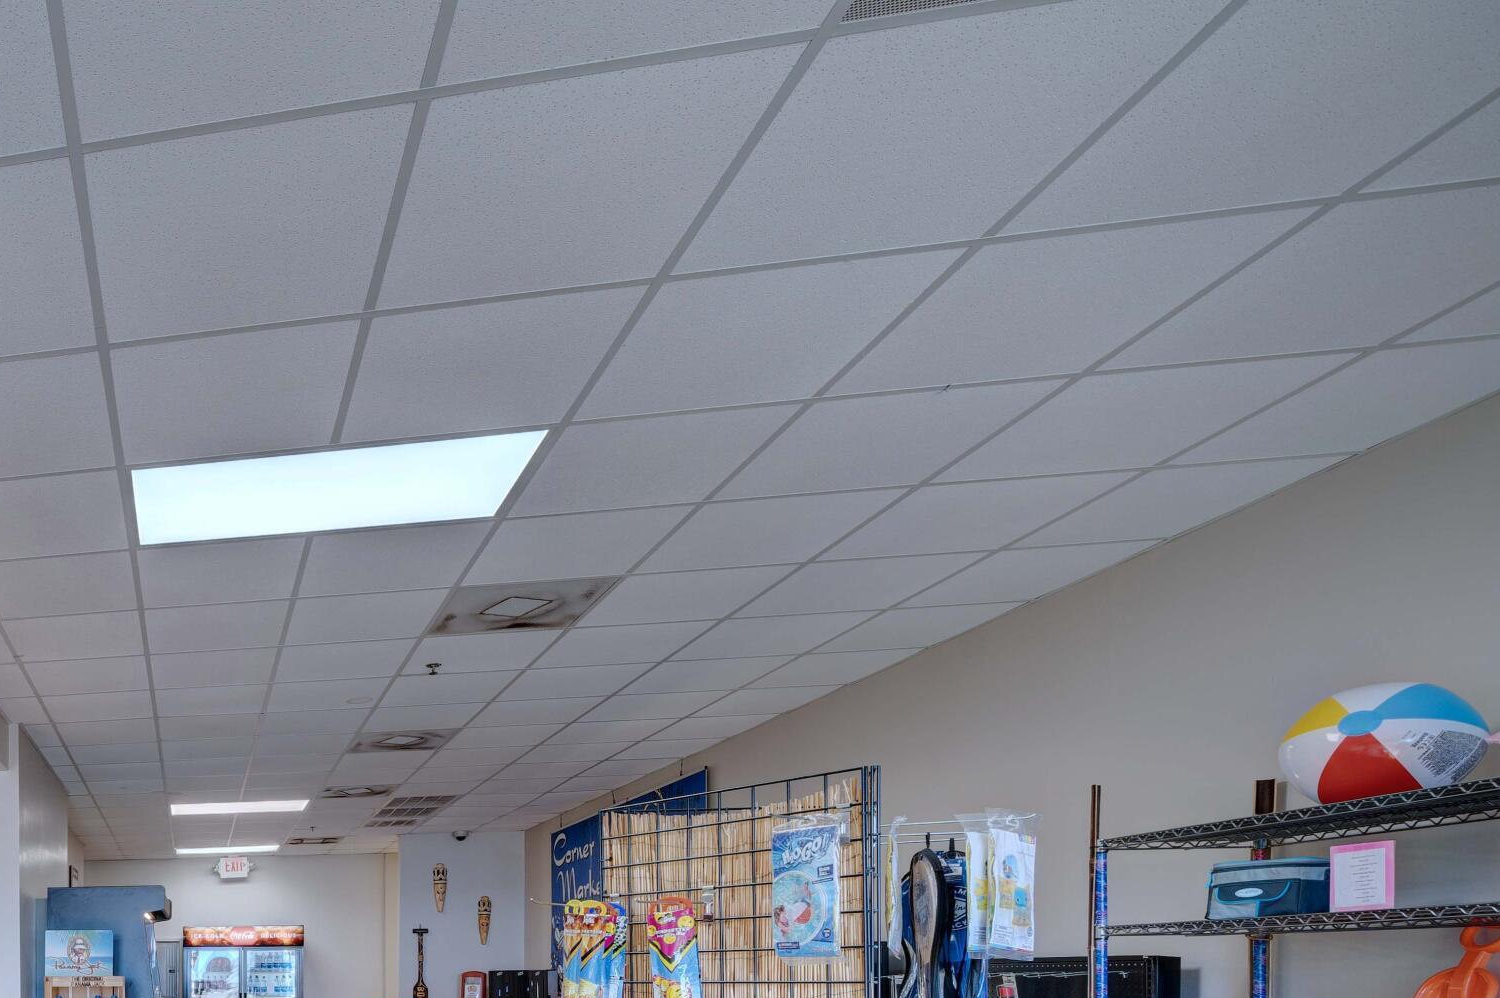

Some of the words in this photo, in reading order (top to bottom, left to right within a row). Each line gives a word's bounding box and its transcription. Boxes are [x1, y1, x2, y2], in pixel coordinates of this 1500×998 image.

[553, 833, 595, 867] Corner
[225, 863, 244, 873] EXIT
[556, 867, 600, 901] Marke
